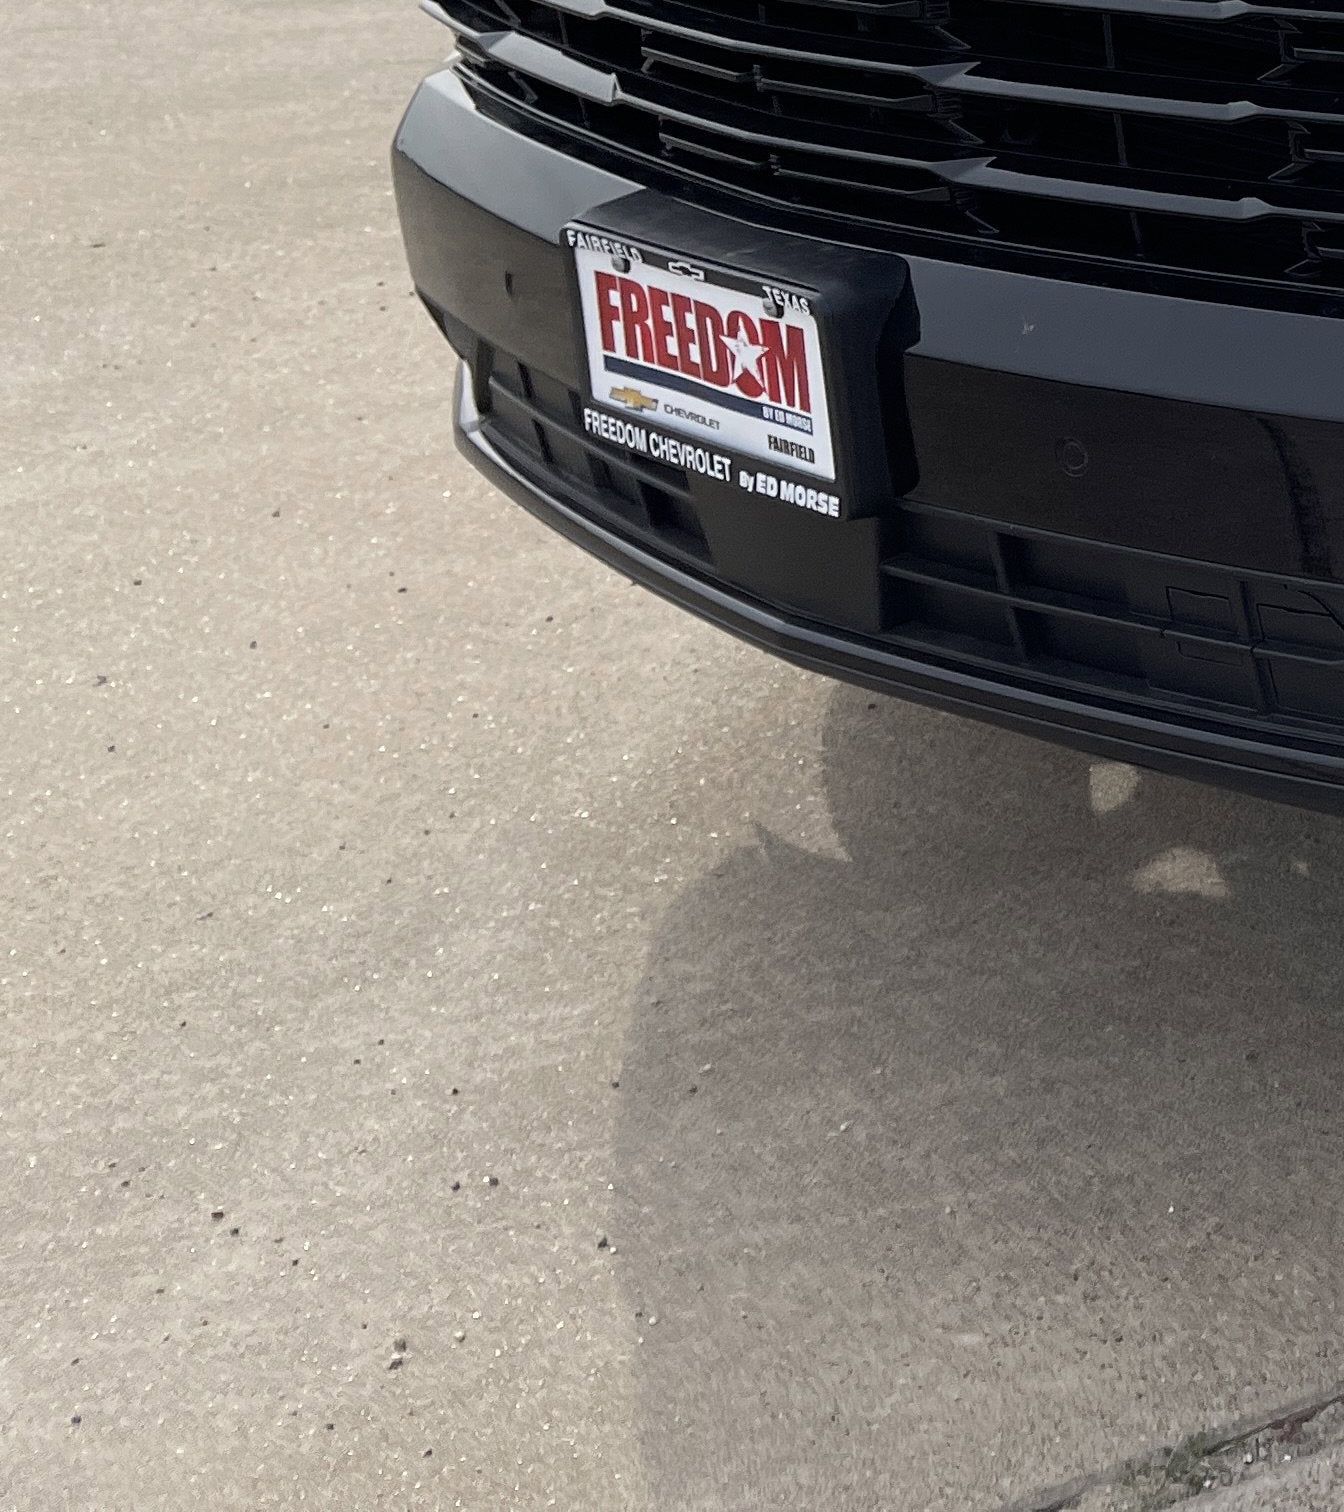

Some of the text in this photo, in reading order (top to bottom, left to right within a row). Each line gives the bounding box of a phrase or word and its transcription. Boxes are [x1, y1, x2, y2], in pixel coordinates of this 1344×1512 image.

[566, 229, 643, 263] FAIRFIELD
[762, 285, 810, 316] TEXAS
[594, 270, 812, 414] FREEDOM
[664, 404, 720, 431] CHEVROLET
[762, 406, 774, 418] BY
[775, 409, 785, 423] ED
[584, 408, 648, 453] FREEDOM
[649, 432, 732, 482] CHEVROLET
[755, 472, 779, 498] ED
[779, 480, 840, 518] MORSE
[767, 434, 815, 464] FAIRFIELD
